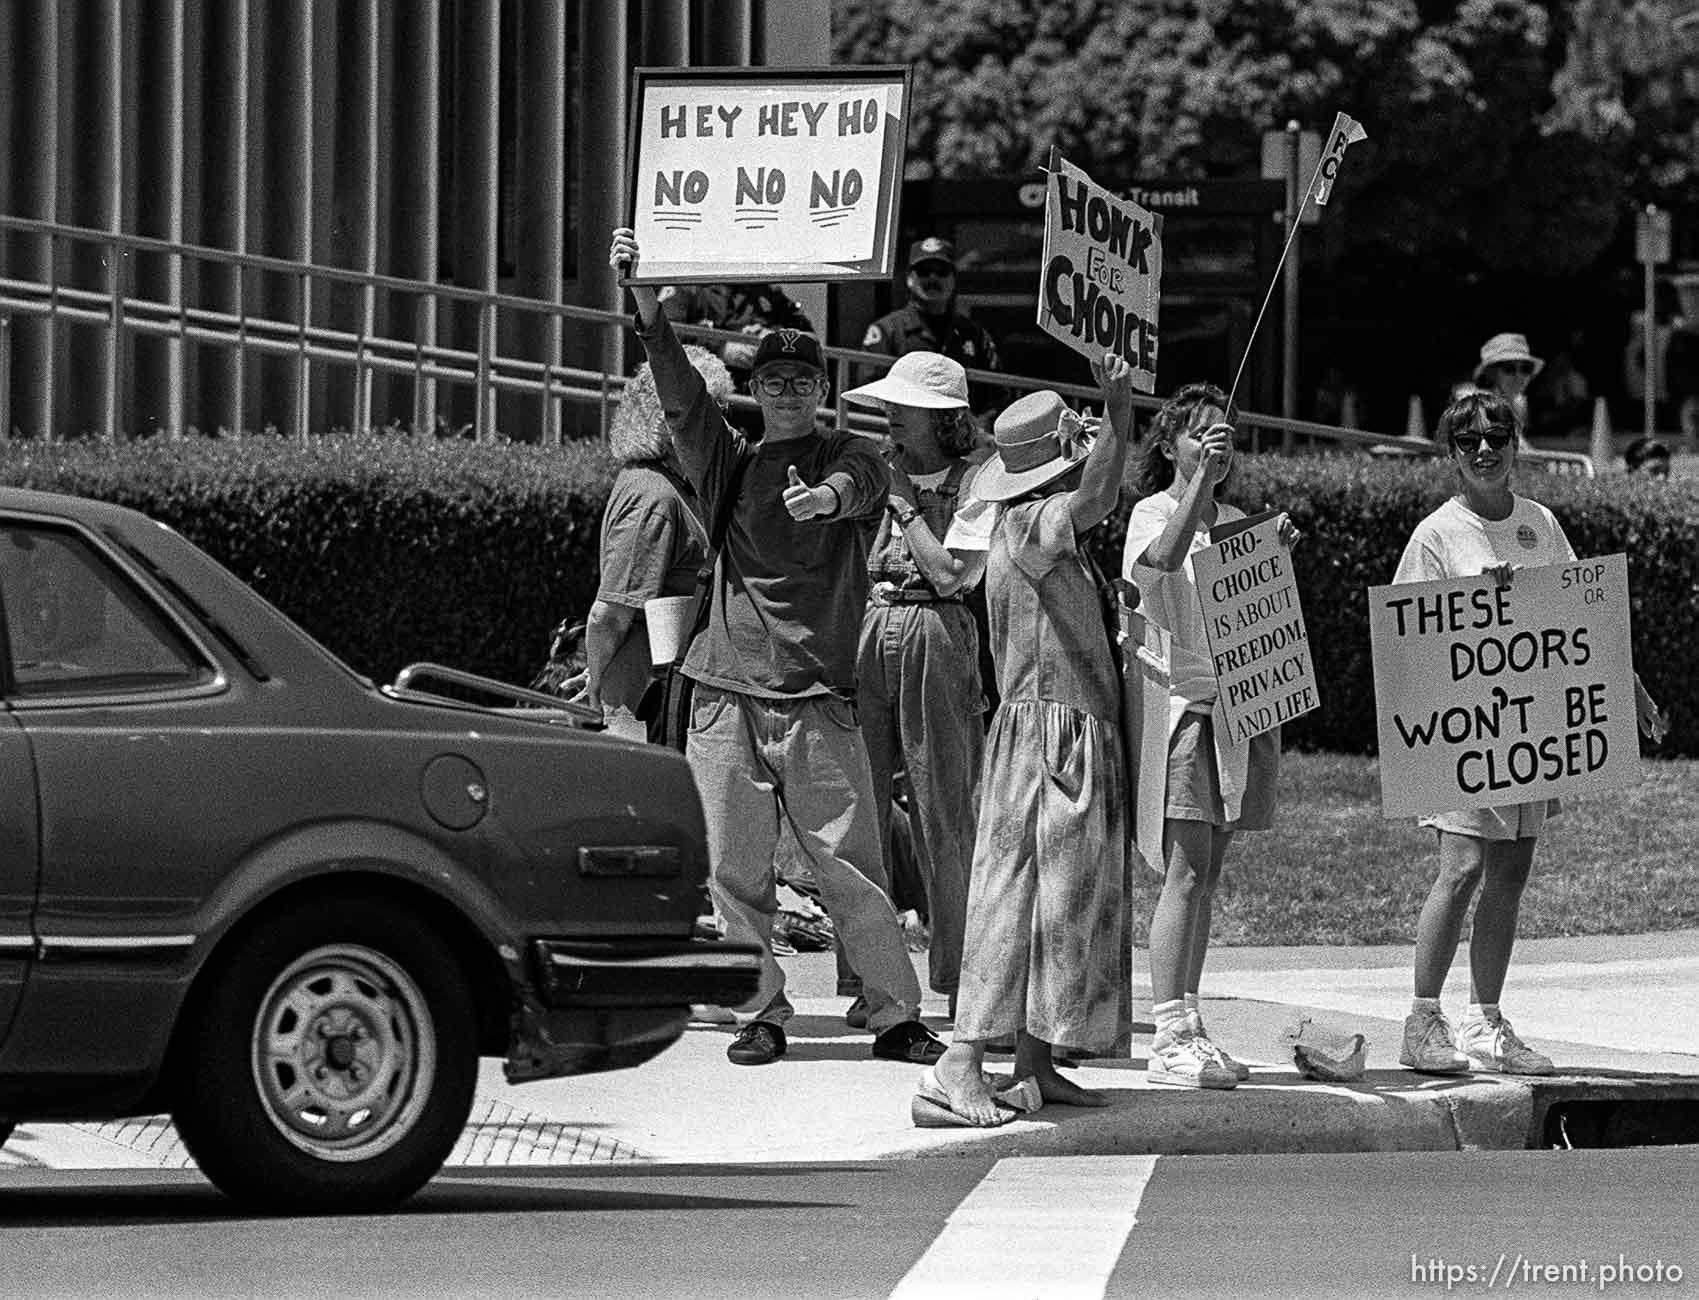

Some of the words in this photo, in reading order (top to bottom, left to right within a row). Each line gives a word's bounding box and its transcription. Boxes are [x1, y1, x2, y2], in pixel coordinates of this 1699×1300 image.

[660, 104, 742, 139] HEY
[758, 101, 829, 137] HEY
[837, 98, 879, 137] HO
[654, 169, 710, 207] NO
[735, 166, 786, 206] NO
[809, 168, 863, 209] NO
[1129, 187, 1199, 206] Transit
[1056, 174, 1153, 275] HONK
[1086, 246, 1125, 294] FOR
[1045, 255, 1159, 374] CHOICE
[779, 328, 801, 353] Y
[1219, 531, 1263, 565] PRO-
[1212, 555, 1283, 603] CHOICE
[1561, 565, 1606, 589] STOP
[1584, 588, 1605, 605] OR
[1214, 614, 1232, 639] IS
[1236, 586, 1293, 631] ABOUT
[1386, 585, 1514, 636] THESE
[1450, 627, 1591, 682] DOORS
[1228, 653, 1306, 707] PRIVACY
[1237, 707, 1272, 742] AND
[1277, 687, 1315, 724] LIFE
[1565, 683, 1609, 728] BE
[1456, 728, 1609, 794] CLOSED
